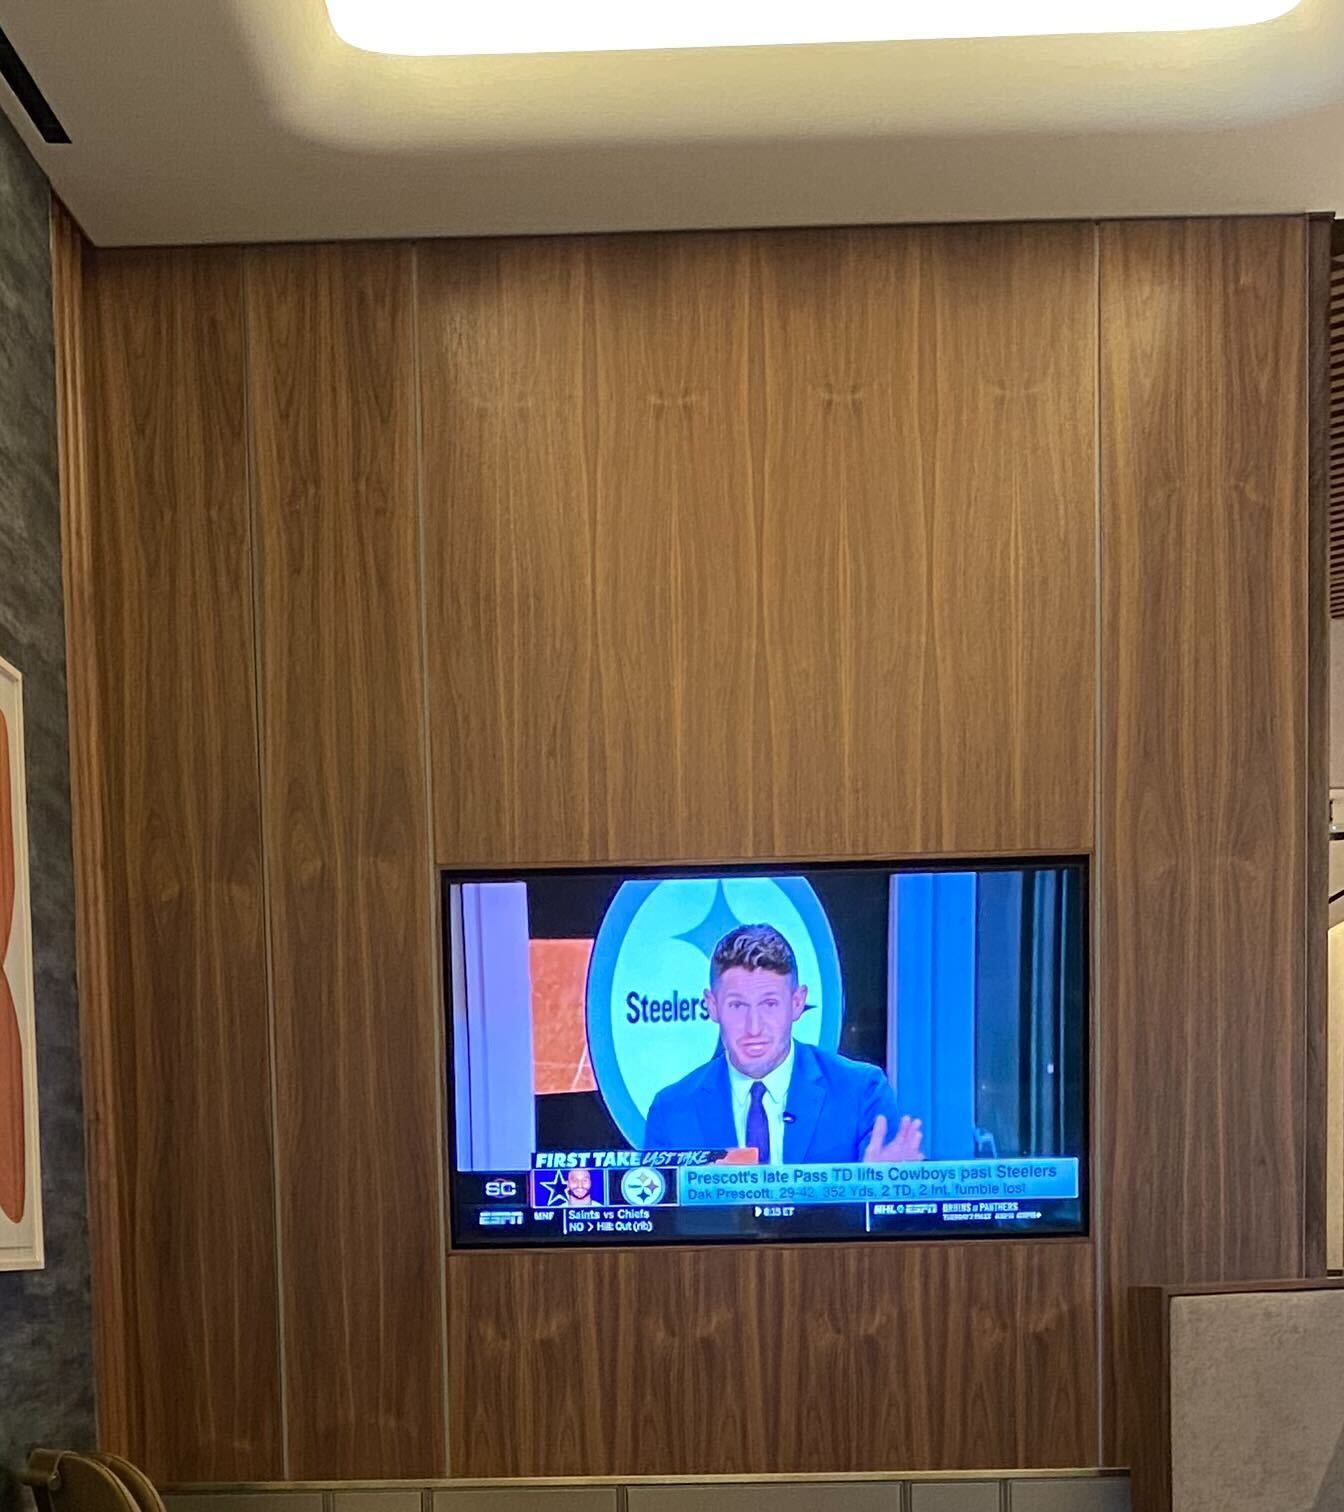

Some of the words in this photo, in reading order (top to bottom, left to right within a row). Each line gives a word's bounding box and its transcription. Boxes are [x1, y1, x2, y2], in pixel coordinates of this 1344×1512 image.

[626, 989, 710, 1024] Steelers
[536, 1152, 590, 1168] FIRST
[592, 1151, 642, 1168] TAKE
[642, 1151, 676, 1166] LAST
[676, 1150, 711, 1166] TAKE
[687, 1170, 759, 1184] Prescott's
[763, 1170, 789, 1183] late
[794, 1169, 828, 1182] Pass
[832, 1168, 853, 1181] TD
[857, 1167, 884, 1181] lifts
[888, 1166, 956, 1182] Cowboys
[961, 1166, 992, 1180] past
[997, 1165, 1057, 1178] Steelers
[485, 1182, 516, 1196] SC
[687, 1189, 712, 1200] Dak
[881, 1185, 891, 1197] 2
[919, 1184, 928, 1196] 2
[1003, 1182, 1026, 1194] lost
[568, 1209, 600, 1220] Saints
[603, 1211, 614, 1219] vs
[617, 1209, 650, 1219] Chiefs
[568, 1222, 584, 1232] NO
